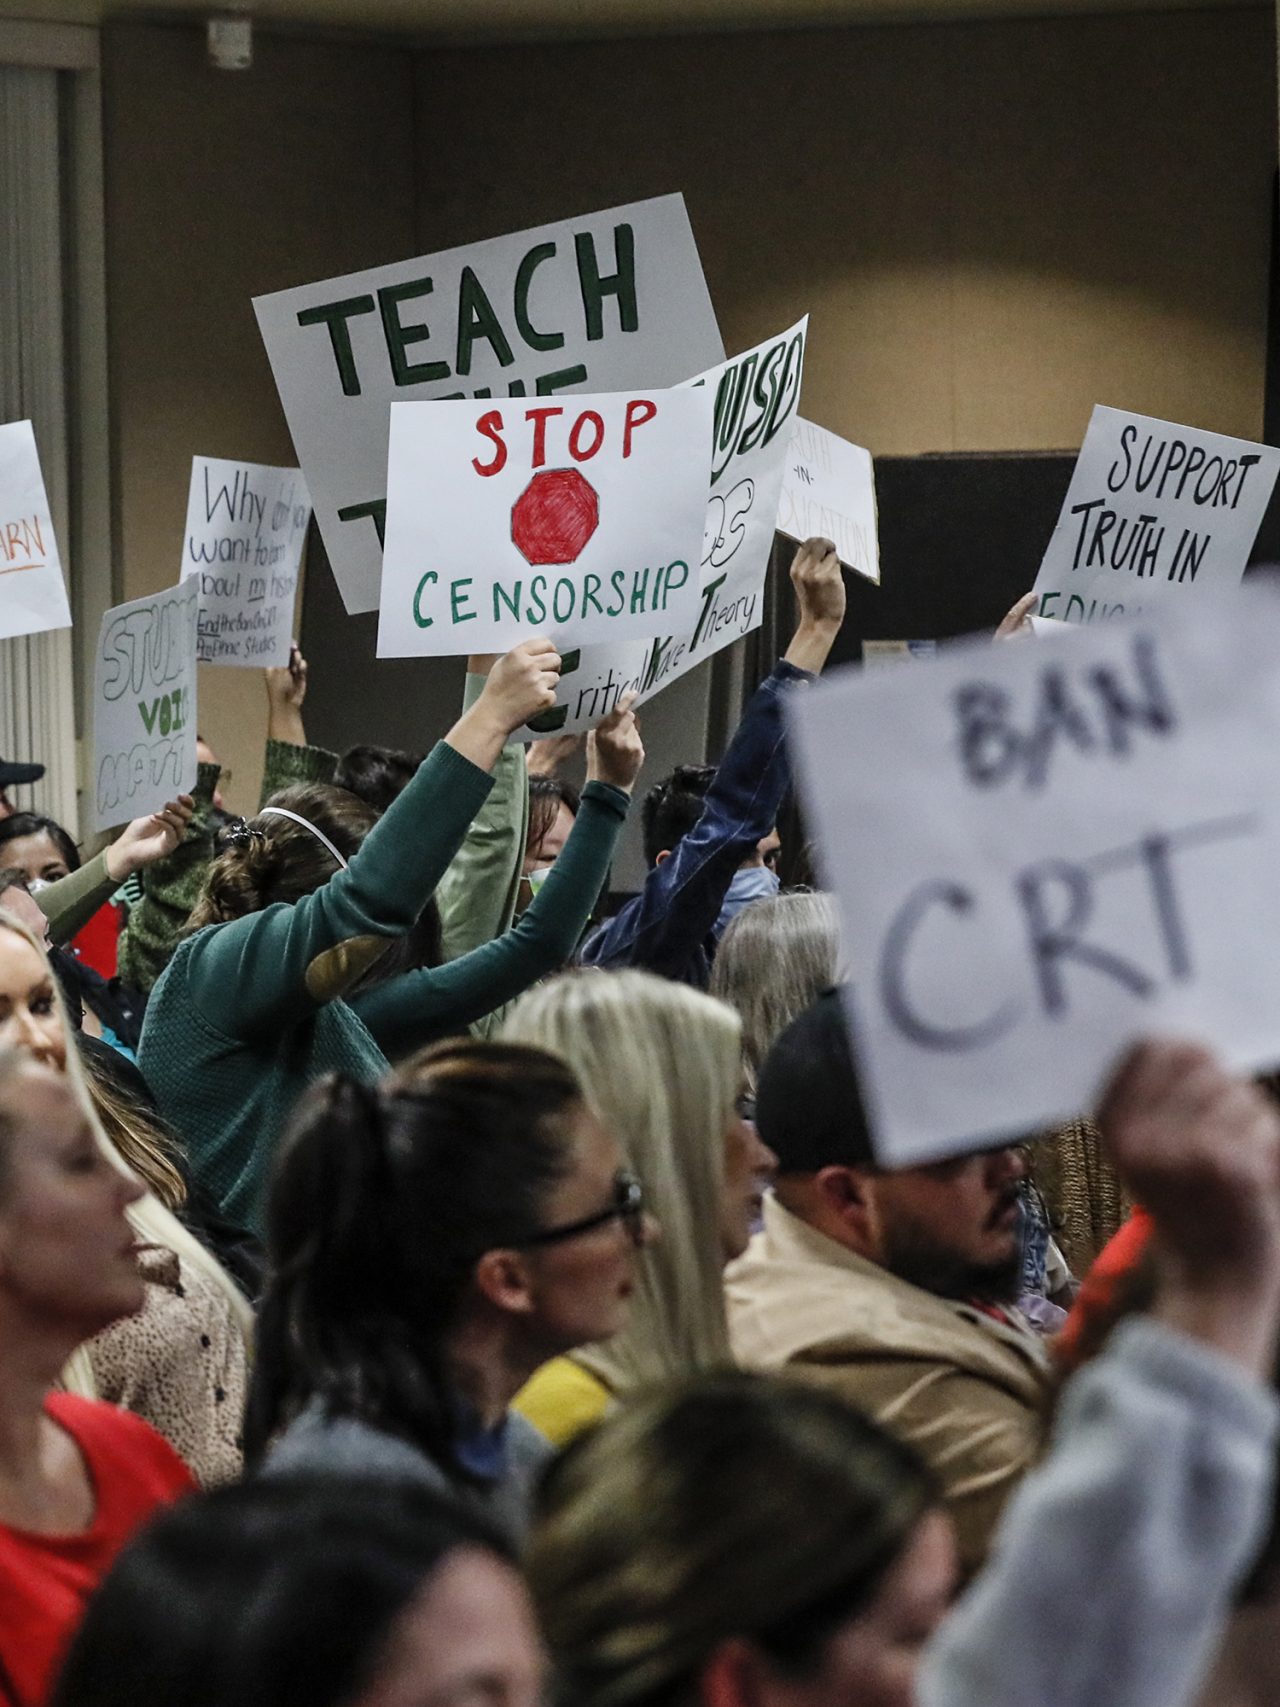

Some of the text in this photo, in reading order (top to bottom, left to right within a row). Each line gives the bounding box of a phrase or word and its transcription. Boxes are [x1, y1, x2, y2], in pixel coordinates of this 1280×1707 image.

[297, 223, 639, 396] TEACH
[472, 399, 658, 478] STOP
[1108, 425, 1261, 509] SUPPORT
[204, 466, 267, 538] Why
[1071, 498, 1211, 583] TRUTH IN
[189, 536, 250, 564] want
[201, 571, 241, 597] bout
[413, 560, 689, 629] CENSORSHIP
[689, 572, 757, 653] Theory
[952, 632, 1176, 787] BAN
[877, 810, 1262, 1054] CRT
